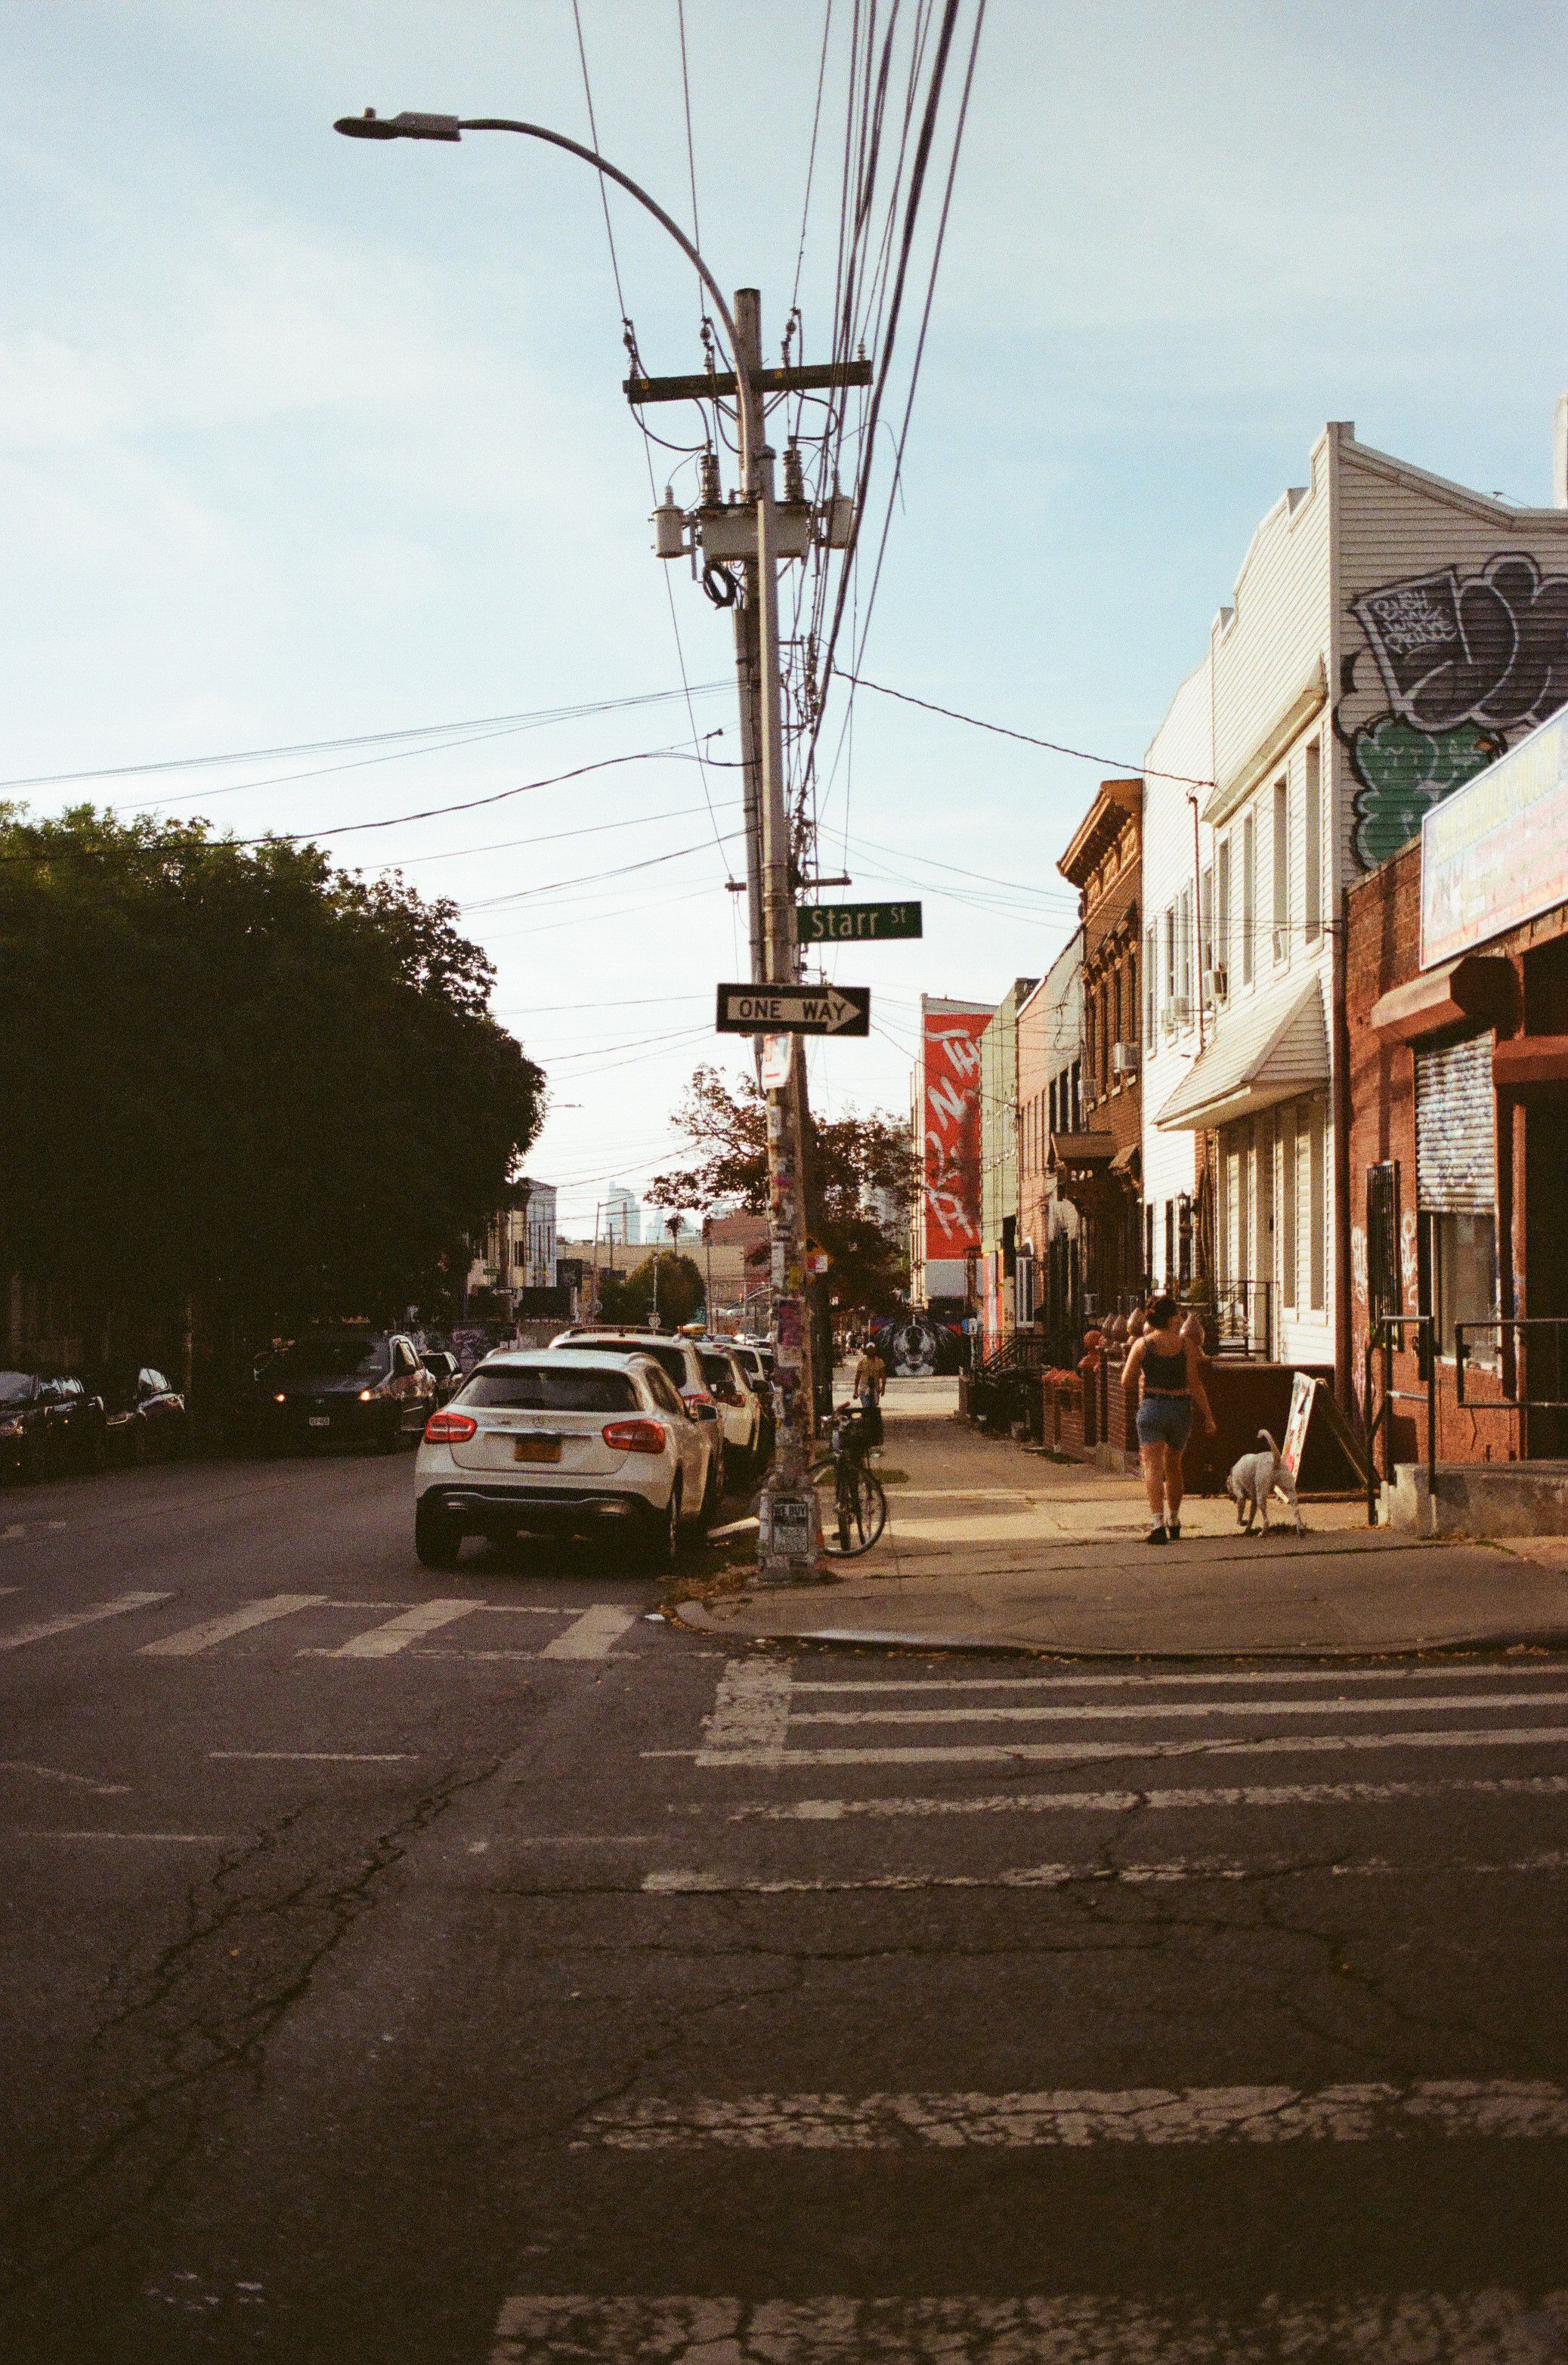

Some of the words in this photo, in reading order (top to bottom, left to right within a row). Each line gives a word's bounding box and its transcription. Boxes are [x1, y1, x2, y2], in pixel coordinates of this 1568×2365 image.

[812, 909, 880, 937] Starr
[890, 906, 907, 924] St
[739, 999, 782, 1019] ONE
[802, 1001, 847, 1020] WAY
